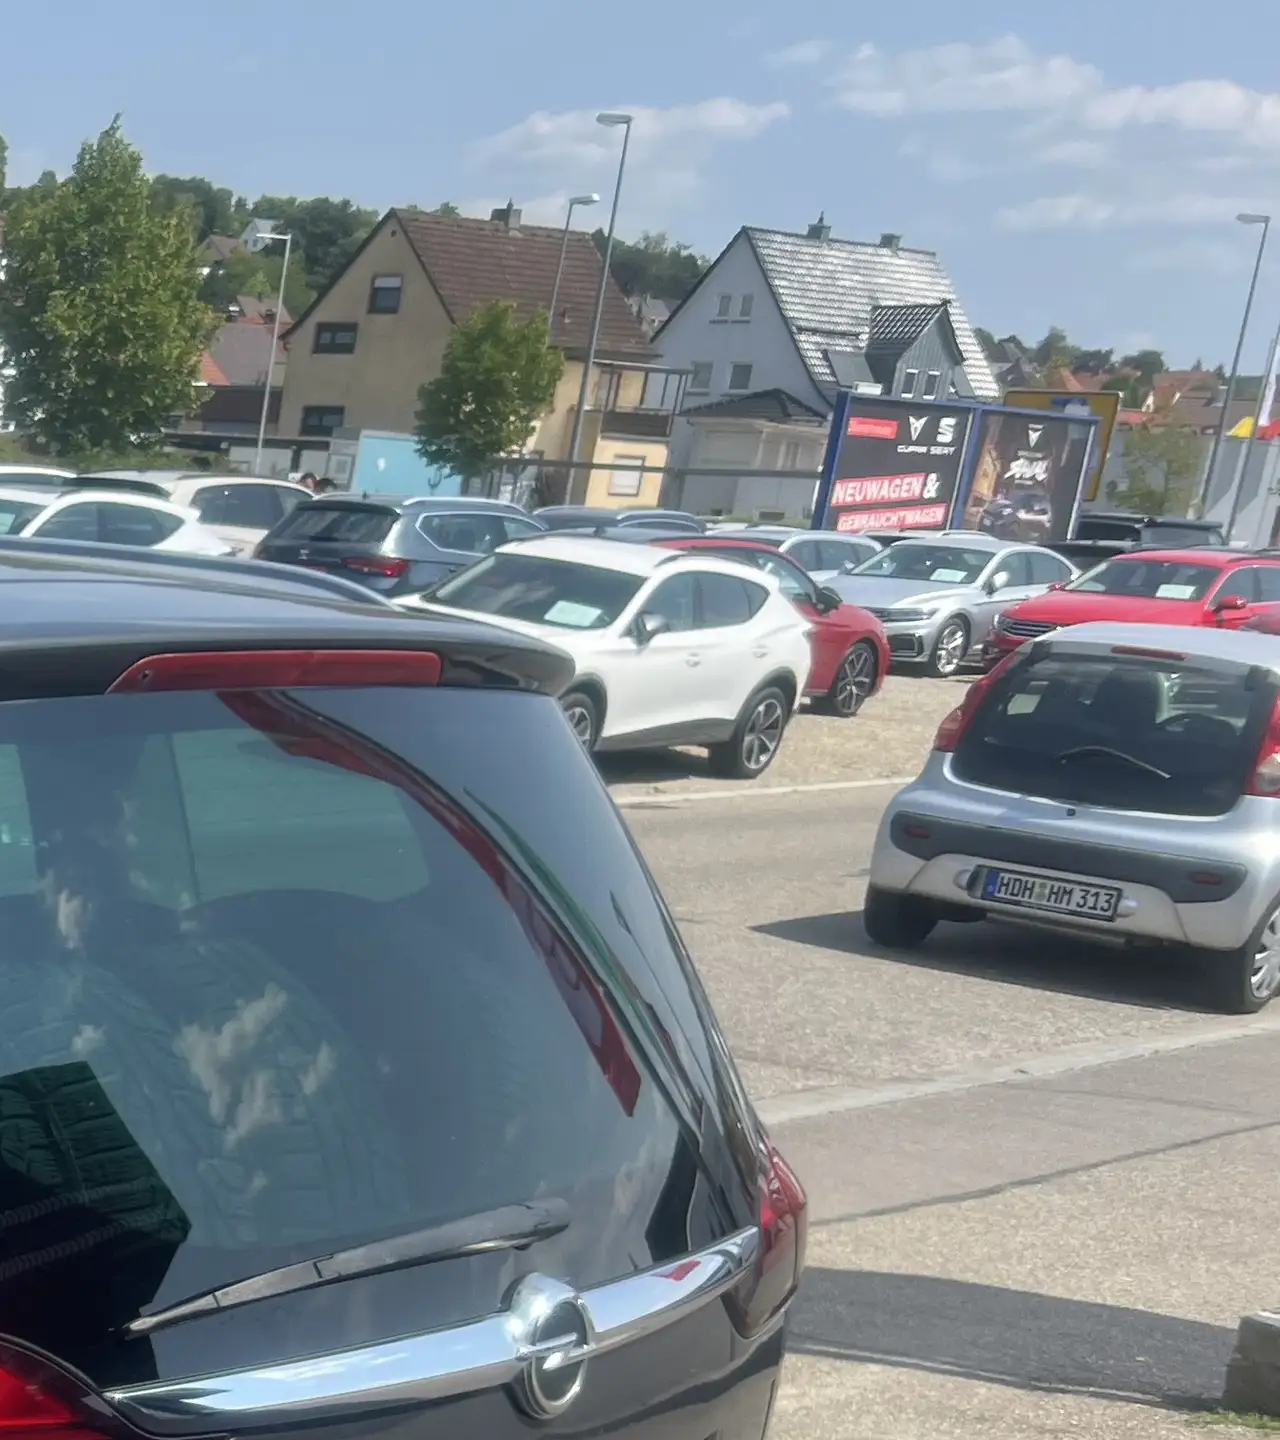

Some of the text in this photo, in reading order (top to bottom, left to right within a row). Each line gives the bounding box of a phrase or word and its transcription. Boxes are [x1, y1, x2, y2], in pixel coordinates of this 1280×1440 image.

[832, 472, 940, 504] NEUWAGEN &
[996, 875, 1036, 900] HDH
[1047, 883, 1074, 906] HM
[1076, 889, 1116, 913] 313
